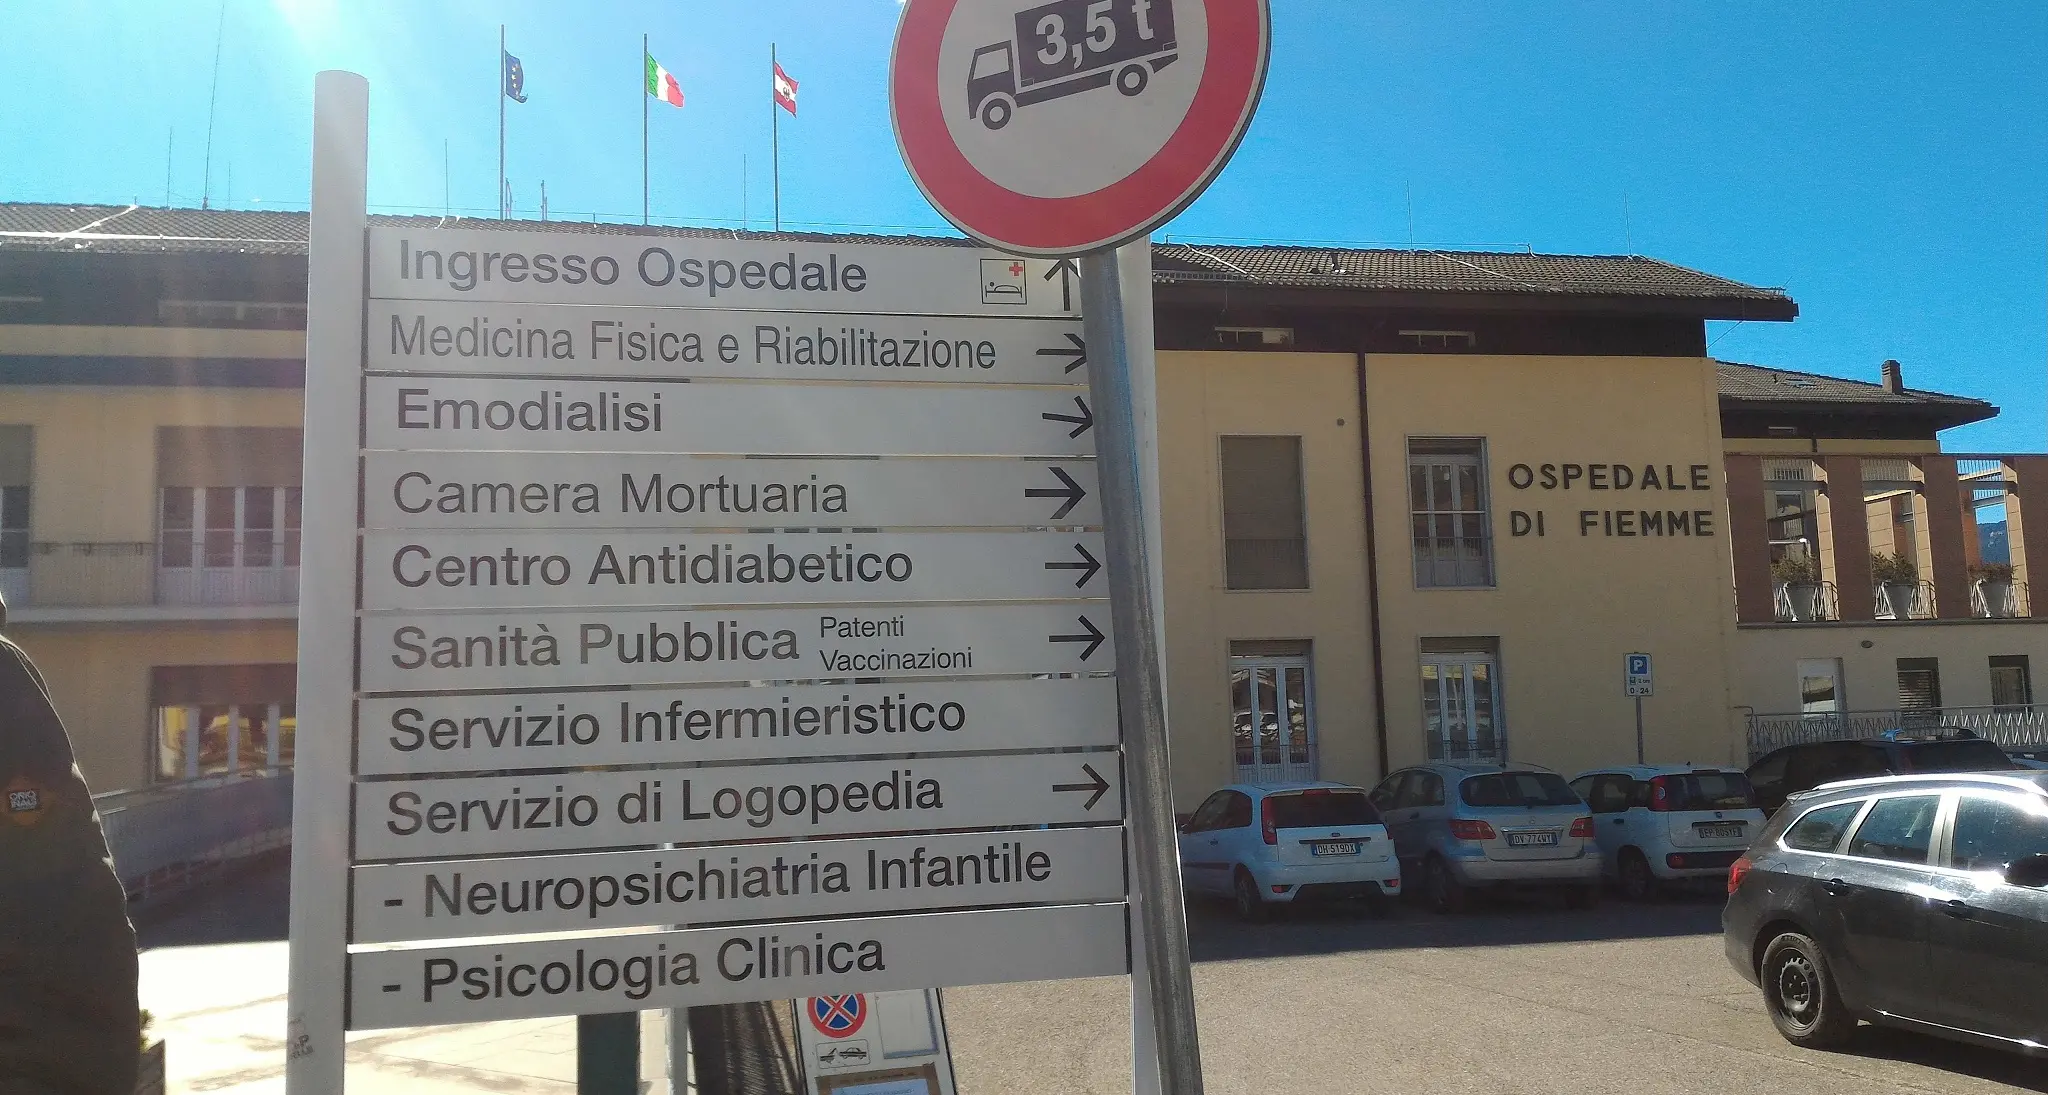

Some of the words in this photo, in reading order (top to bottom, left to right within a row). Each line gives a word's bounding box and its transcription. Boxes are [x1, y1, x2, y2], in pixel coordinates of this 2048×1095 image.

[1036, 0, 1116, 70] 3,5
[1131, 0, 1154, 40] t
[400, 239, 620, 292] Ingresso
[637, 246, 867, 298] Ospedale
[390, 314, 575, 360] Medicina
[591, 320, 704, 363] Fisica
[717, 333, 739, 364] e
[754, 325, 996, 369] Riabilitazione
[398, 388, 662, 432] Emodialisi
[393, 471, 600, 514] Camera
[620, 473, 848, 513] Mortuaria
[1508, 463, 1711, 490] OSPEDALE
[1510, 510, 1545, 537] DI
[1579, 510, 1715, 537] FIEMME
[392, 544, 572, 588] Centro
[587, 543, 913, 585] Antidiabetico
[391, 623, 561, 670] Sanità
[579, 620, 800, 665] Pubblica
[820, 615, 905, 639] Patenti
[819, 646, 973, 672] Vaccinazioni
[1633, 659, 1644, 671] P
[389, 703, 600, 752] Servizio
[620, 693, 966, 743] Infermieristico
[387, 785, 599, 836] Servizio
[617, 780, 662, 825] di
[682, 769, 944, 829] Logopedia
[424, 852, 851, 919] Neuropsichiatria
[867, 841, 1052, 891] Infantile
[423, 943, 700, 1003] Psicologia
[716, 932, 886, 982] Clinica
